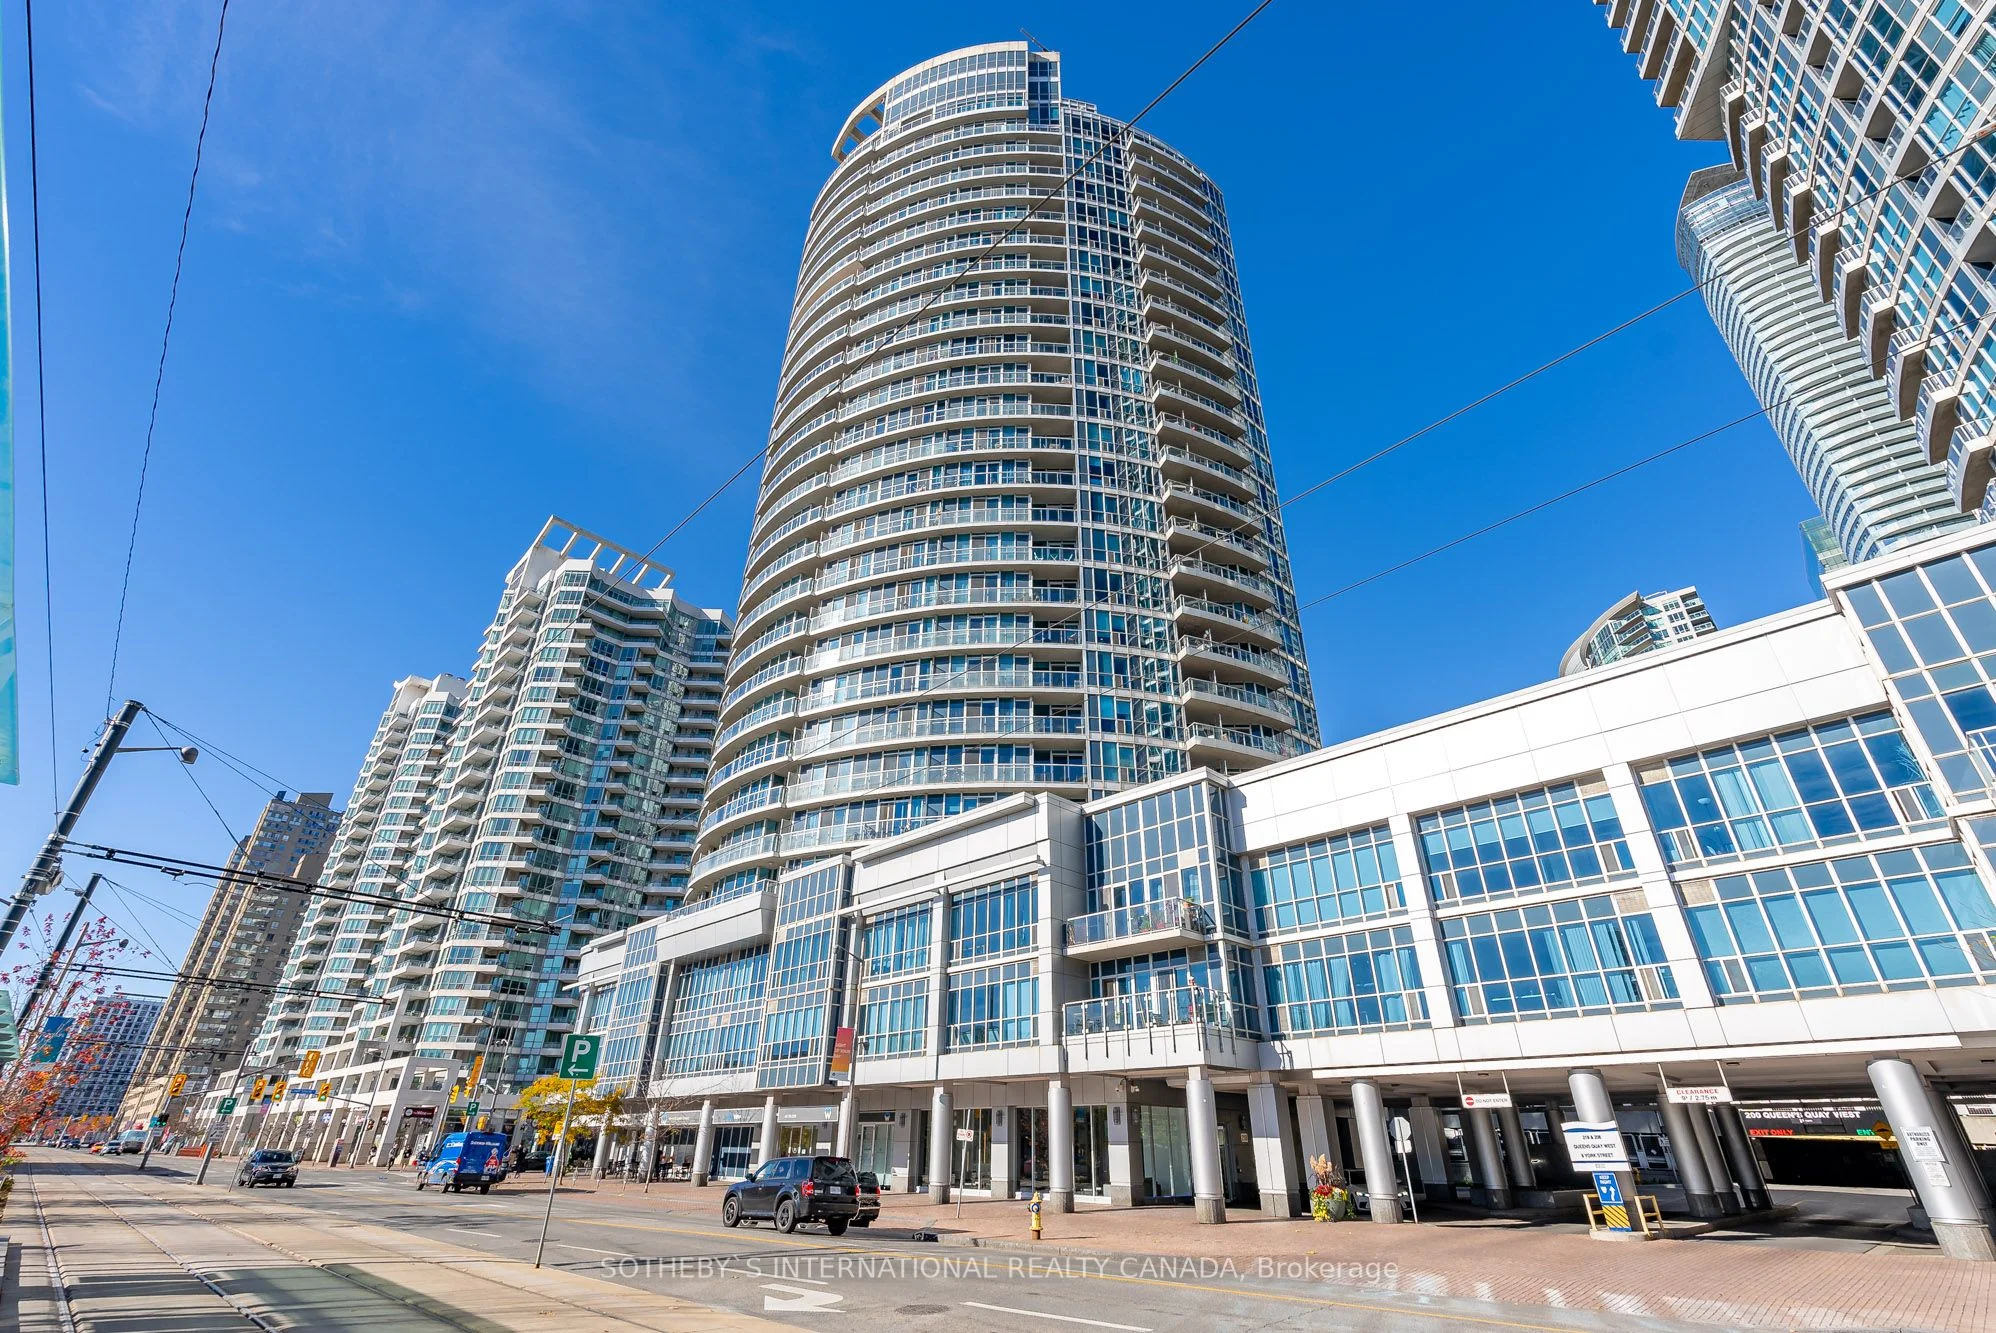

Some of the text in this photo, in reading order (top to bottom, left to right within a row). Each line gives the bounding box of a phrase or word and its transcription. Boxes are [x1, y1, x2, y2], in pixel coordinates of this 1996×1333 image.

[571, 1039, 591, 1063] P
[223, 1099, 233, 1108] P
[469, 1103, 477, 1111] P
[1805, 1111, 1831, 1119] QUAY
[1834, 1111, 1861, 1119] WEST
